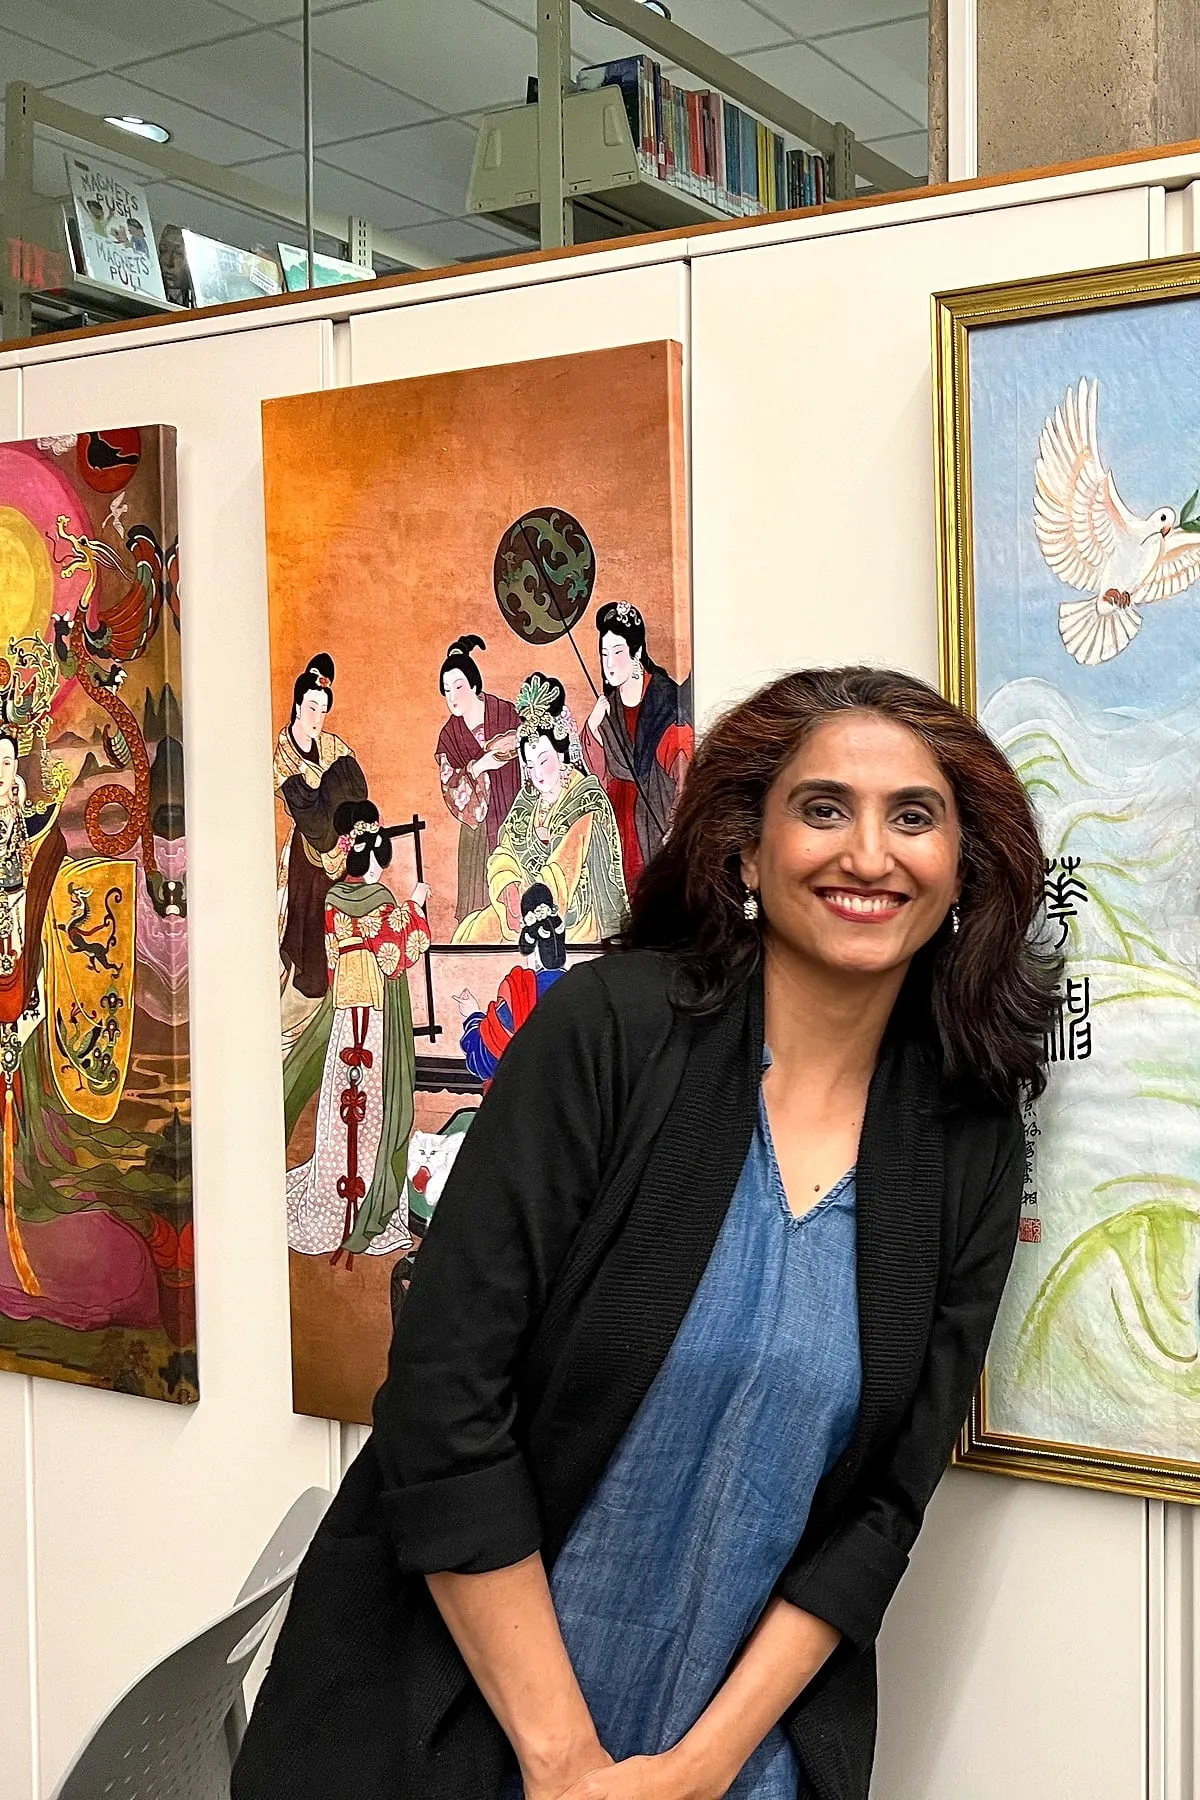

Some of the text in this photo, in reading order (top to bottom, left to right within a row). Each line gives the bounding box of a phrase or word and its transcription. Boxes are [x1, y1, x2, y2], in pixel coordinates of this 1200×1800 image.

[81, 173, 138, 210] MAGNETS
[96, 193, 132, 219] PUSH
[96, 240, 150, 275] MAGNETS
